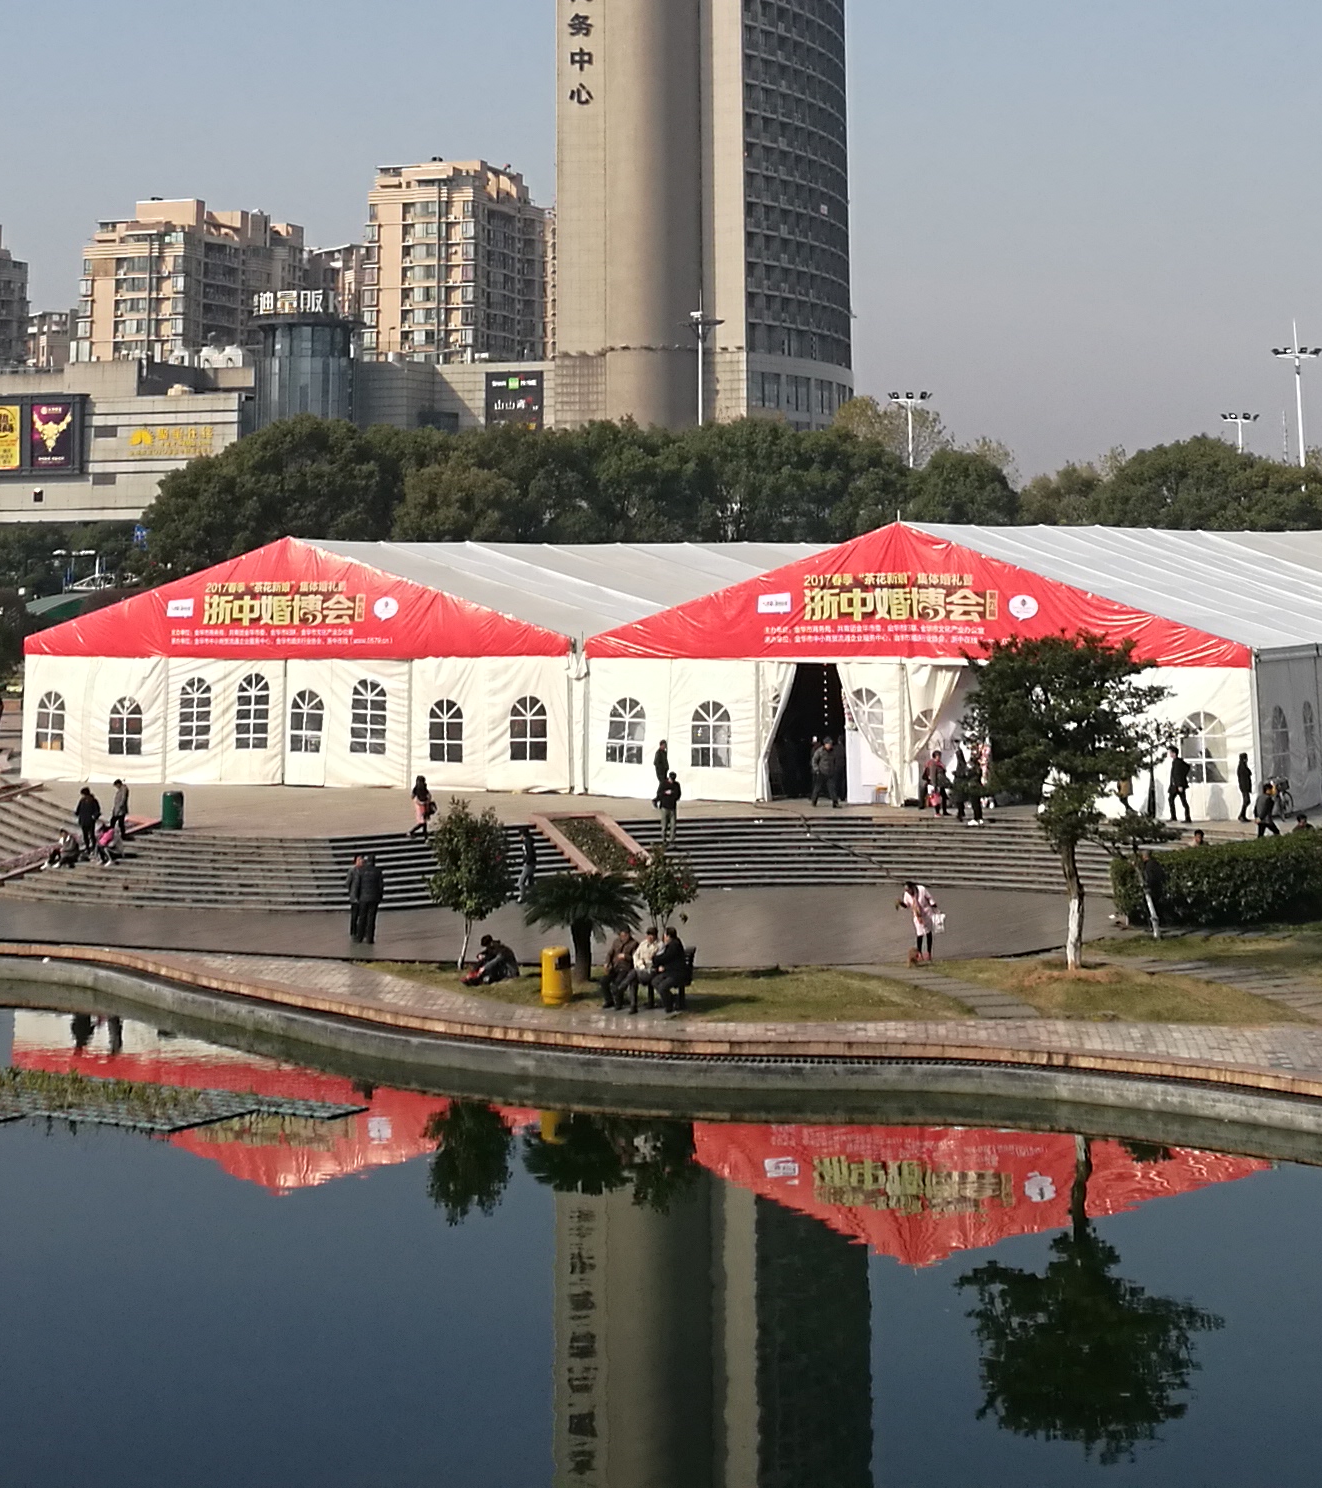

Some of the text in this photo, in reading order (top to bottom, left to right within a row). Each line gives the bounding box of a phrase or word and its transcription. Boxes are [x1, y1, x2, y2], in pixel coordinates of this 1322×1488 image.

[203, 594, 355, 625] 浙中婚博会
[804, 587, 984, 622] 浙中婚博会
